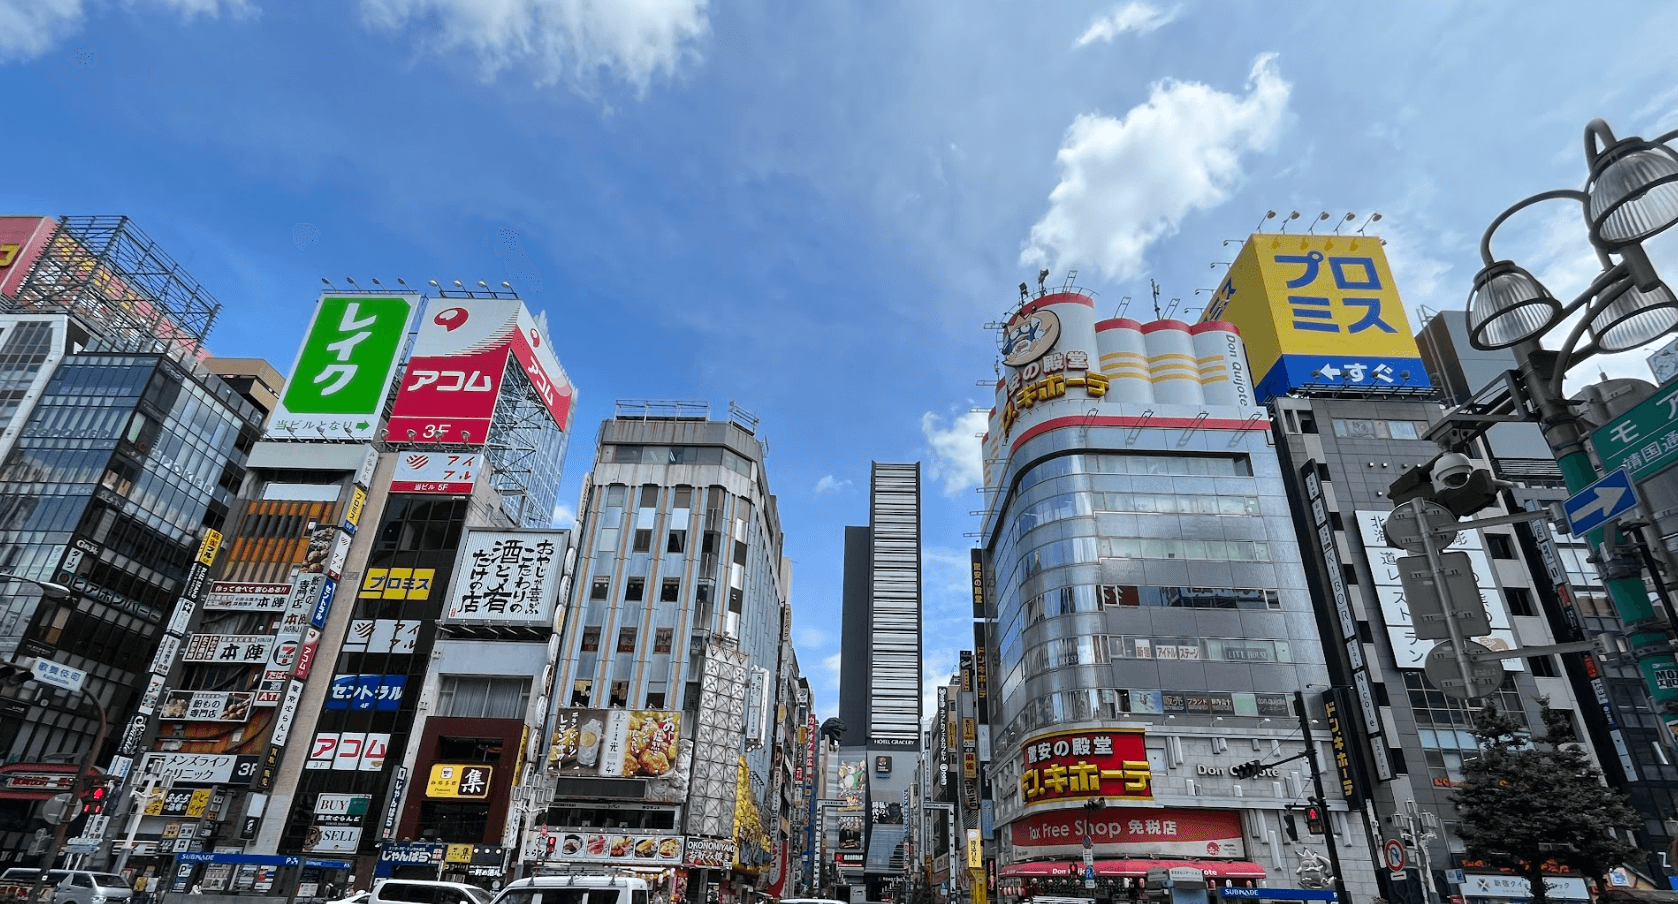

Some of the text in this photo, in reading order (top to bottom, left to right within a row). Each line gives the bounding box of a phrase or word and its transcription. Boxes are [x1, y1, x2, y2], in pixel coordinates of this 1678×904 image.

[1274, 250, 1382, 290] プロ
[1288, 296, 1399, 334] ミス
[313, 302, 377, 396] レイク
[408, 370, 492, 392] アコム
[529, 356, 554, 405] アコム
[1226, 333, 1247, 407] Don Quijote
[1343, 363, 1394, 383] すぐ
[423, 424, 451, 438] 3F
[437, 483, 449, 491] 5F
[370, 576, 429, 590] プロミス
[457, 550, 495, 613] だけの店
[483, 540, 524, 614] 酒と肴
[510, 548, 535, 613] こだわりの
[292, 580, 310, 609] 専門店
[220, 643, 267, 660] 本陣
[299, 646, 312, 670] アコム
[1157, 647, 1177, 659] アイドル
[1180, 648, 1199, 659] ステージ
[332, 683, 403, 700] セントラル
[312, 738, 386, 758] アコム
[1028, 735, 1113, 764] 驚安の殿堂
[1325, 701, 1354, 797] ドン・キホーテ
[166, 755, 230, 768] メンズライフ
[1197, 765, 1225, 776] Don
[461, 768, 486, 794] 集
[1021, 760, 1151, 800] ドン・キホーテ
[320, 799, 348, 811] BUY
[964, 780, 977, 808] CASINO
[323, 829, 357, 842] SELL
[1029, 818, 1177, 840] Tax Free Shop 免税店
[687, 841, 734, 852] OKONOMIYAKI
[1225, 888, 1260, 897] SUBNADE
